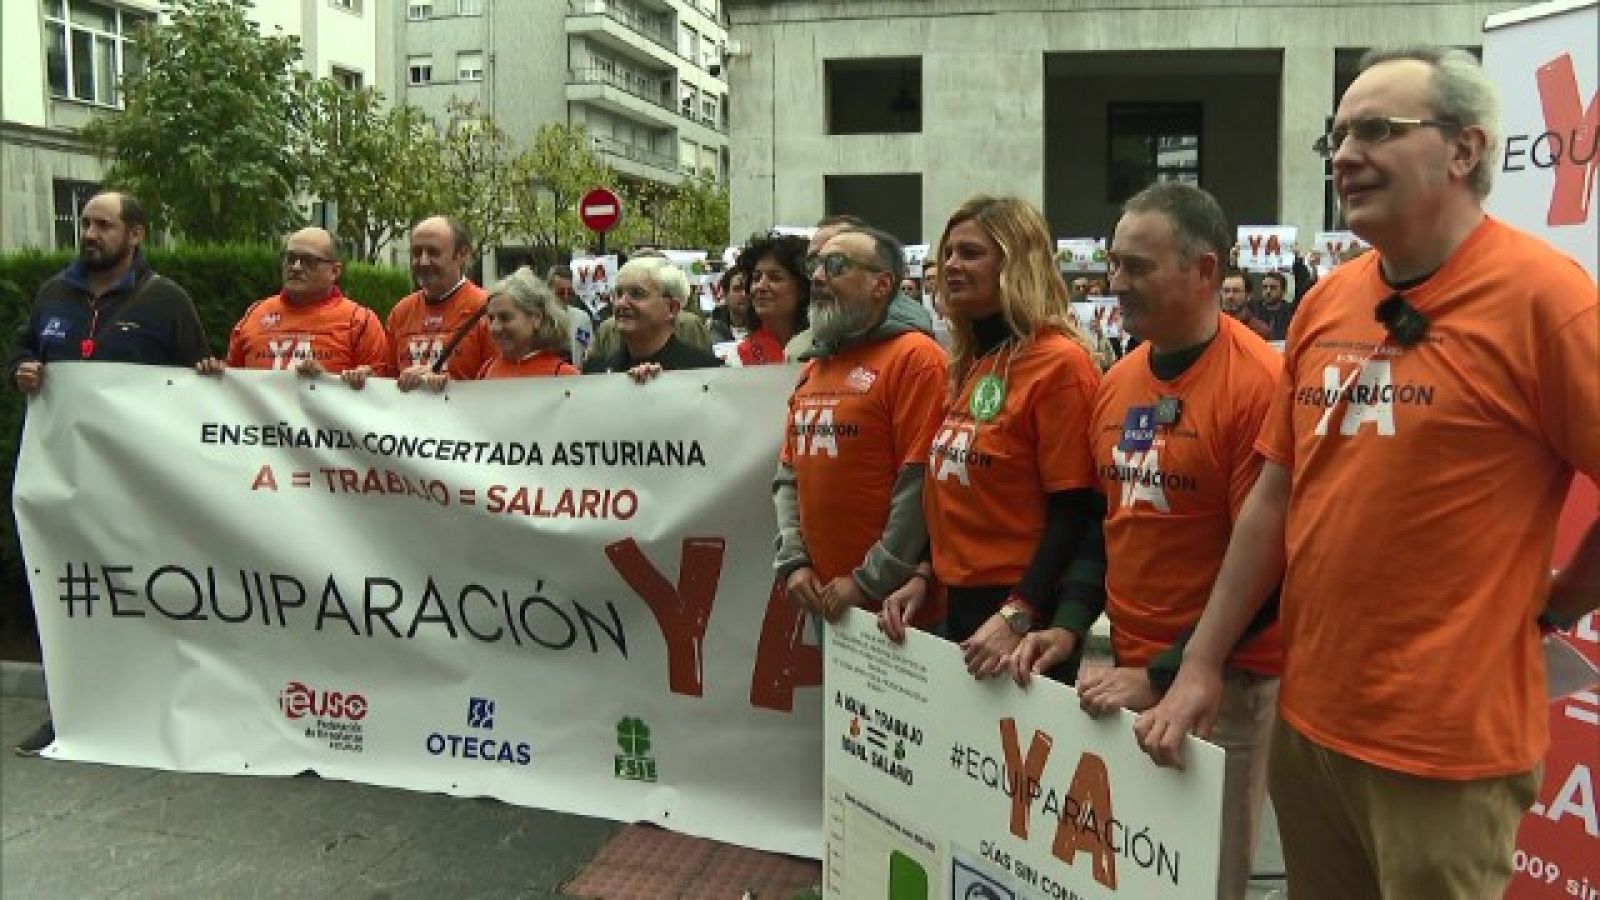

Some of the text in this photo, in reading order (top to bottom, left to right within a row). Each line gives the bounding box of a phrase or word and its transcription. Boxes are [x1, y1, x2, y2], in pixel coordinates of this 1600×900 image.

[1247, 234, 1281, 256] YA
[362, 431, 544, 467] CONCERTADA
[551, 439, 707, 468] ASTURIANA
[251, 464, 279, 492] A
[486, 484, 639, 521] SALARIO
[57, 560, 630, 661] #EQUIPARACIÓN
[425, 733, 532, 765] OTECAS
[949, 741, 1181, 887] #EQUIPARACIÓN
[999, 716, 1119, 891] YA
